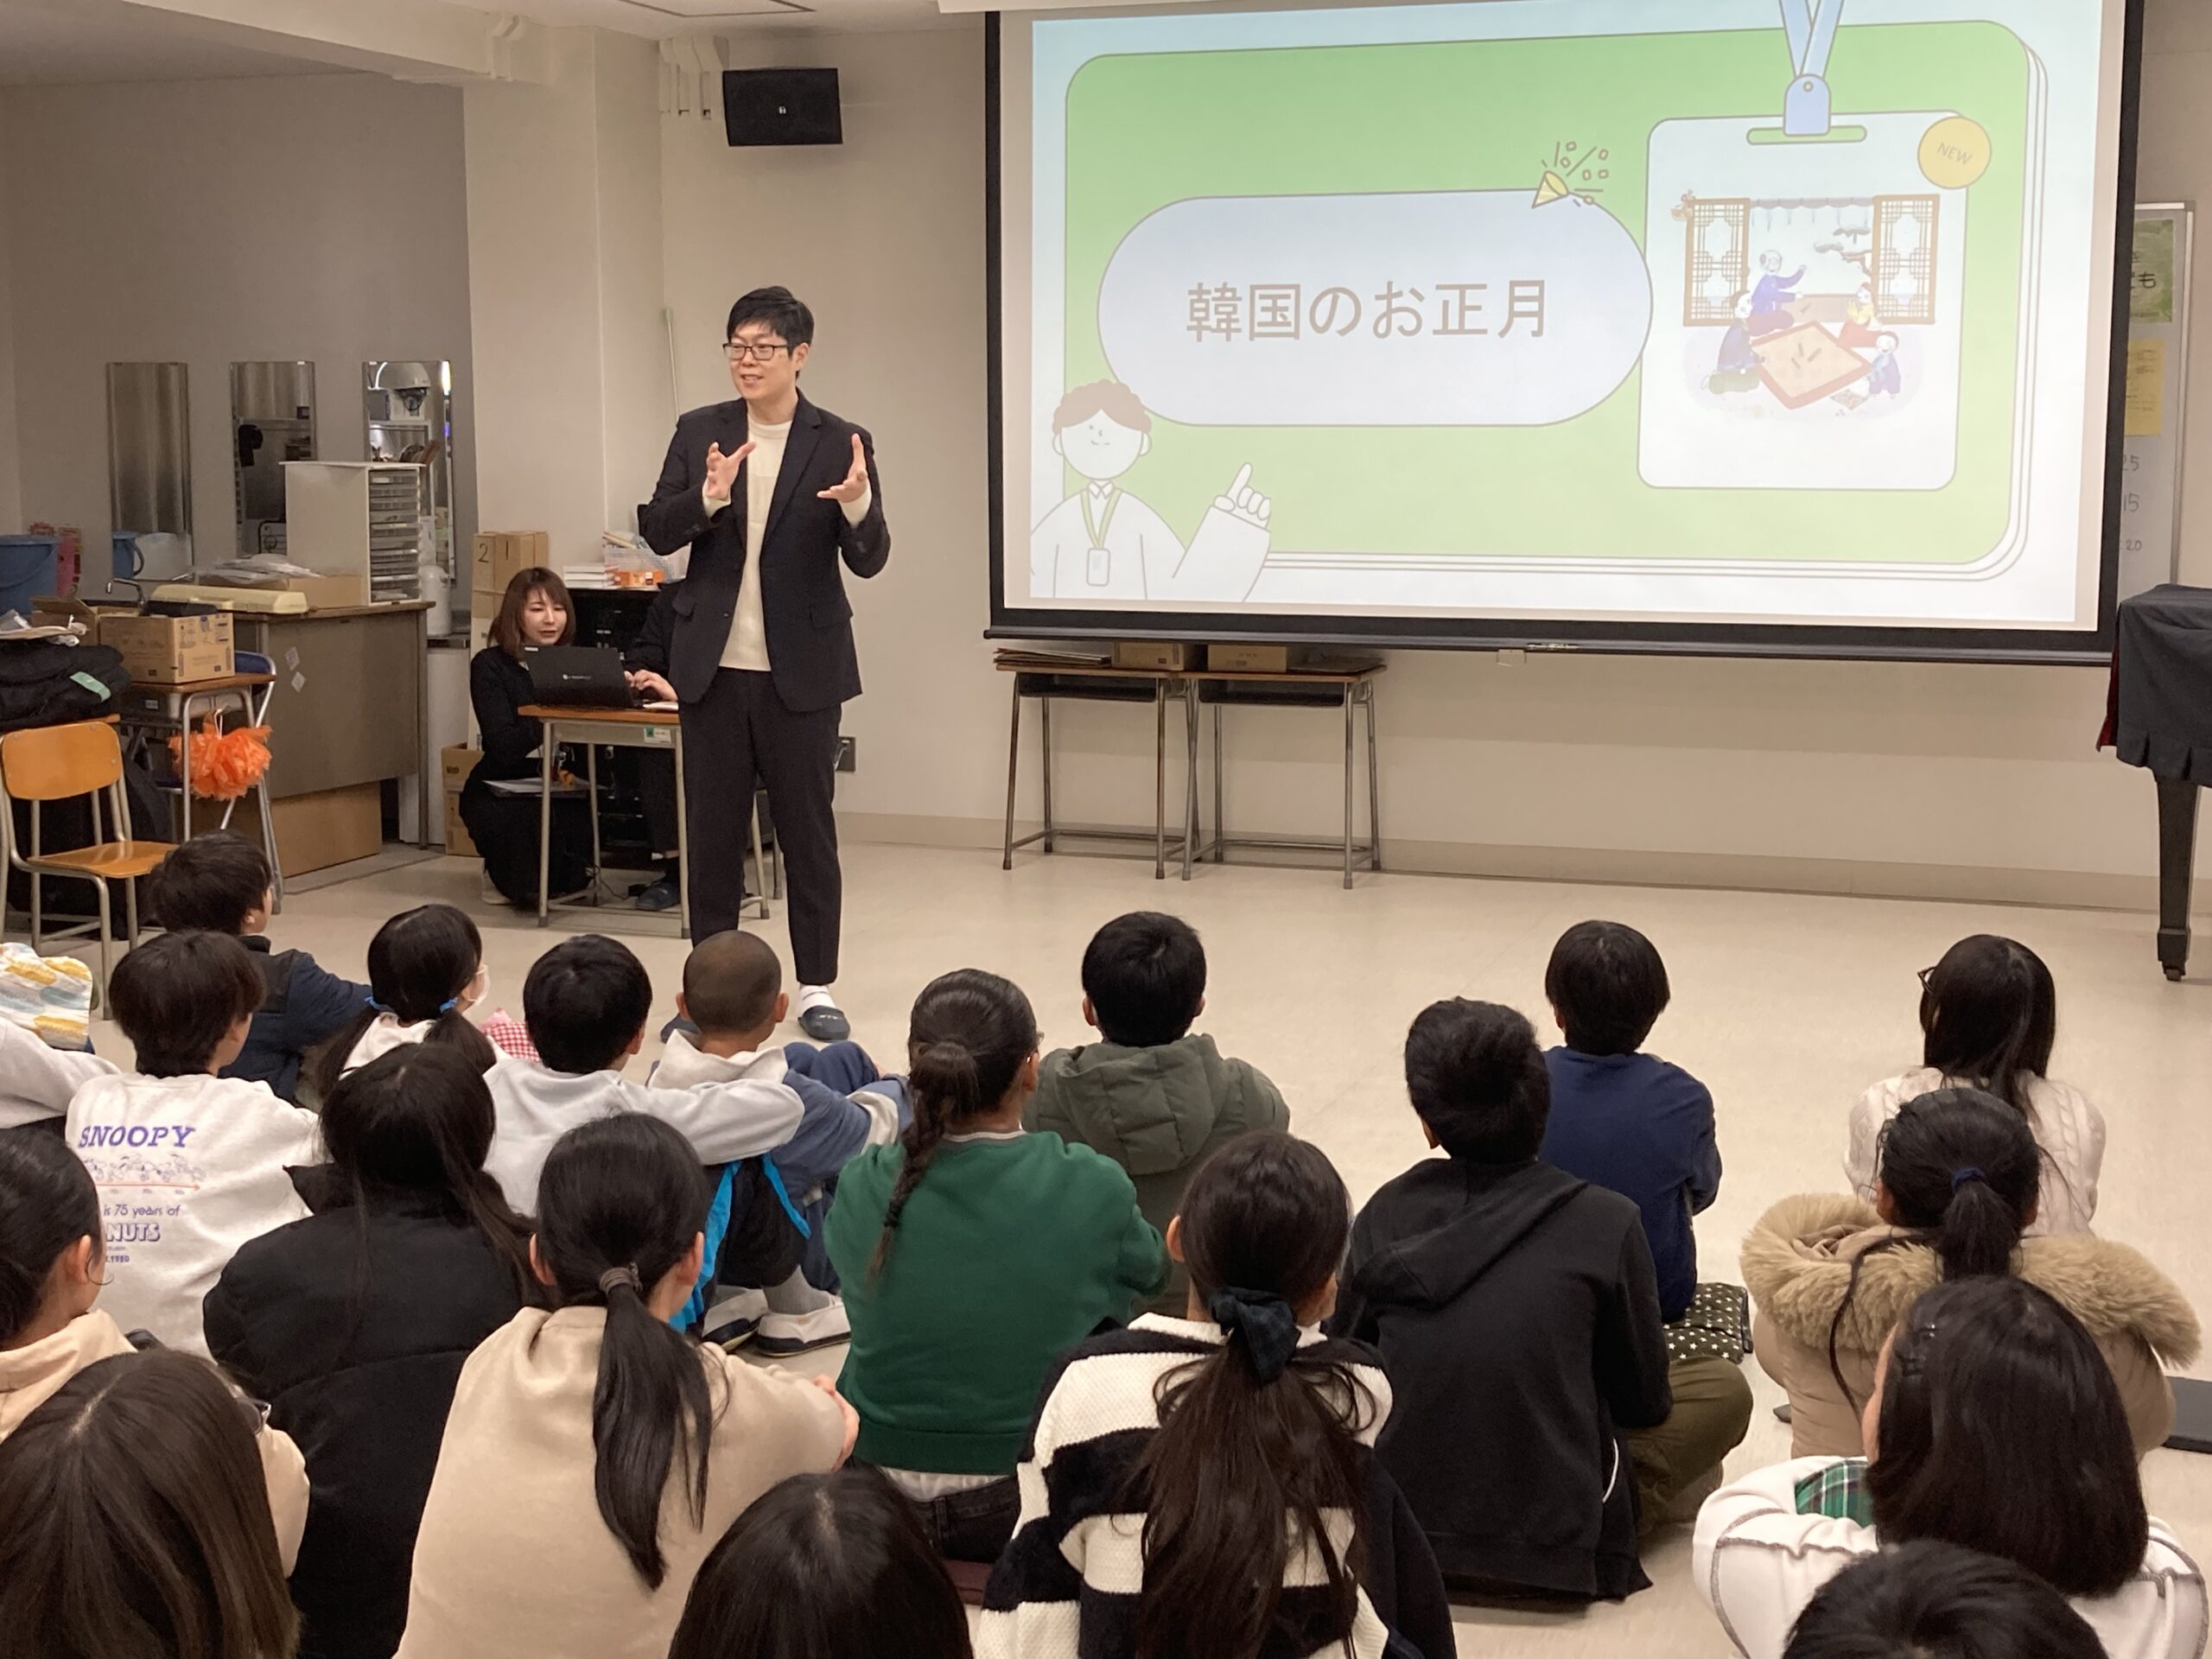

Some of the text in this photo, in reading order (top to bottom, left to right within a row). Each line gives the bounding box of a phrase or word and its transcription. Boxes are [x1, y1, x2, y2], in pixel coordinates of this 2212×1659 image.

[1937, 142, 1973, 165] NEW
[1186, 280, 1545, 342] 韓国のお正月
[478, 543, 489, 563] 2
[505, 540, 509, 561] 1
[78, 1125, 196, 1148] SNOOPY
[114, 1204, 129, 1216] 75
[132, 1206, 162, 1218] years
[167, 1205, 181, 1216] of
[105, 1223, 161, 1242] NUTS
